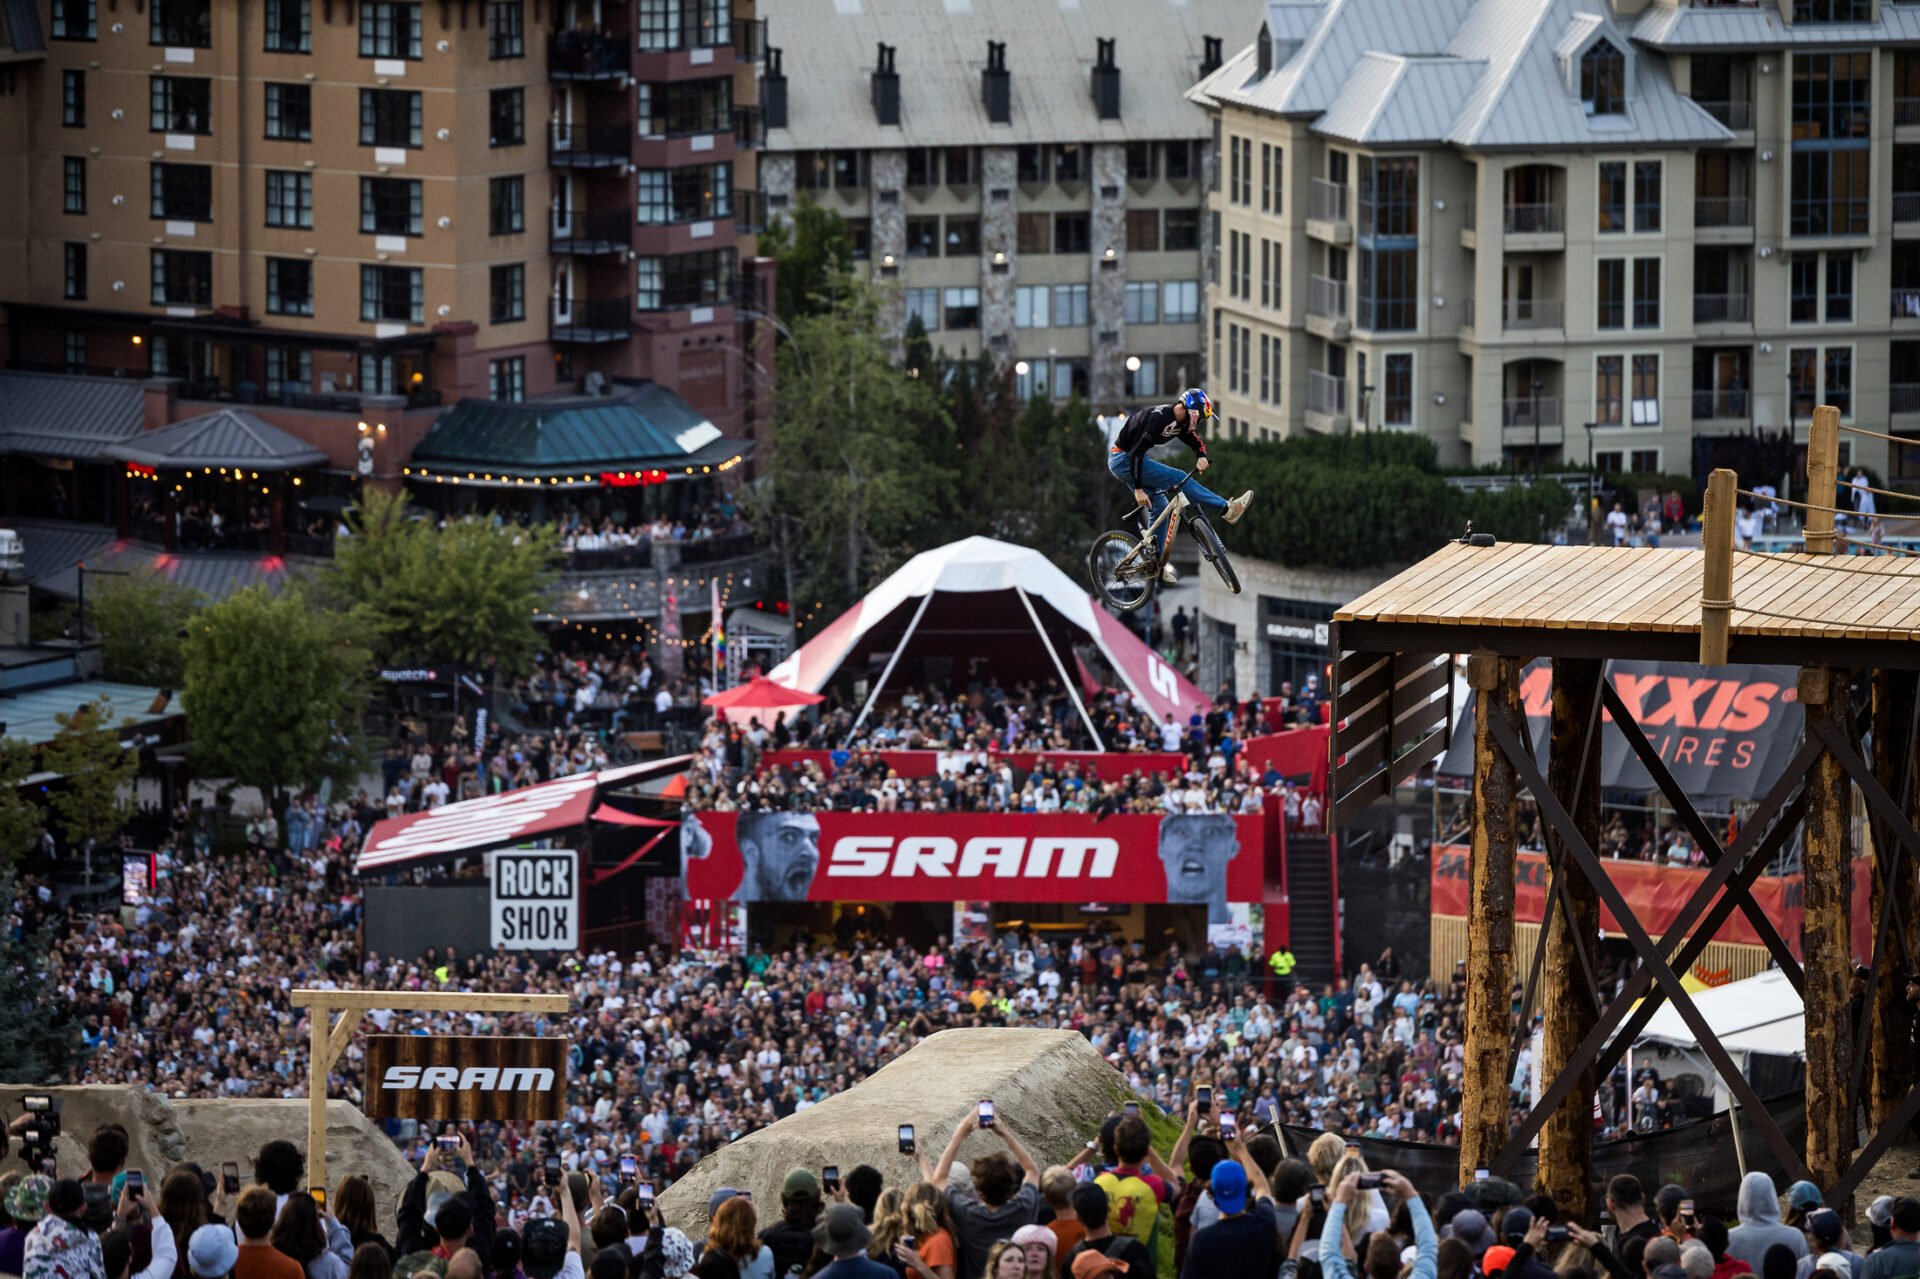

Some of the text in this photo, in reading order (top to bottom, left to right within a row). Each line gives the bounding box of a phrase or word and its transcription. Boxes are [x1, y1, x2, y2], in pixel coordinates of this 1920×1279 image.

[826, 836, 1120, 878] SRAM
[500, 859, 569, 896] ROCK
[502, 906, 568, 940] SHOX
[381, 1066, 555, 1092] SRAM
